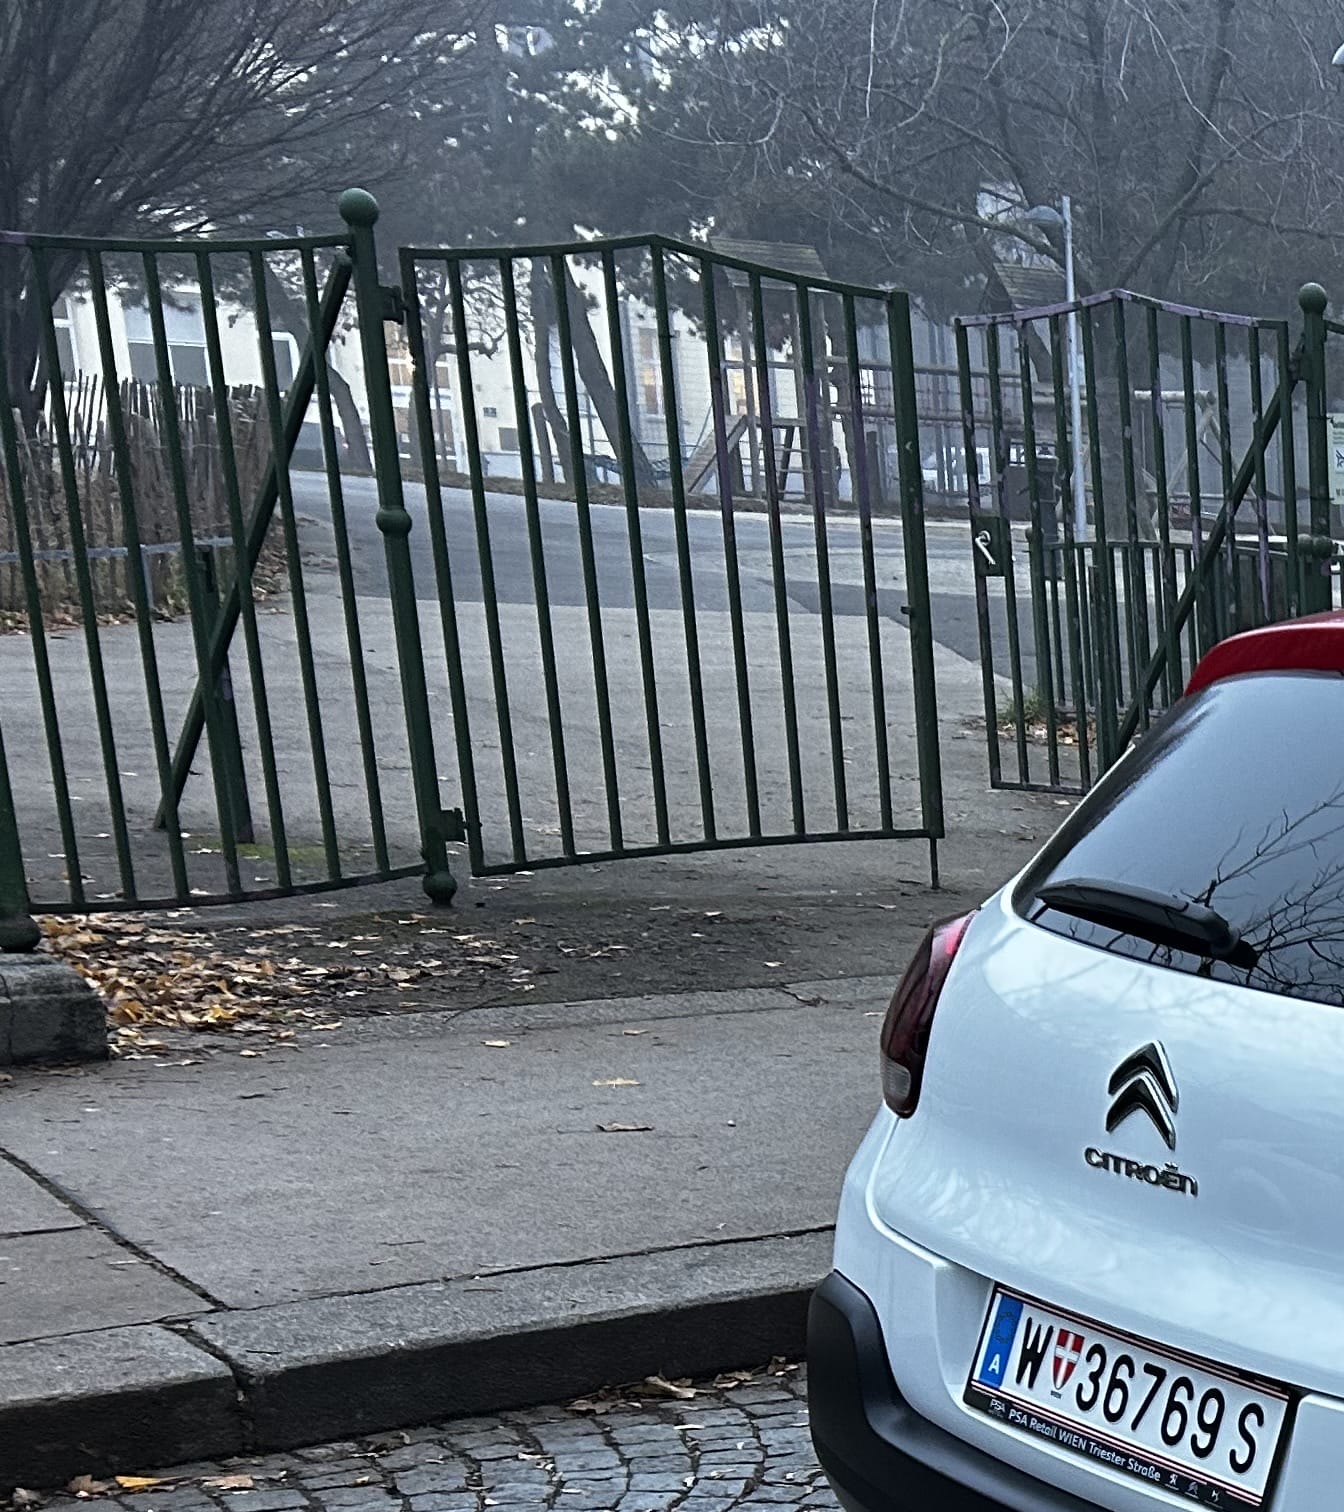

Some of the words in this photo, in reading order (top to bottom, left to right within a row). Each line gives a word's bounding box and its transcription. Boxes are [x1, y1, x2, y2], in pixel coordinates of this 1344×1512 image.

[1084, 1146, 1198, 1197] CITROËN
[988, 1353, 1001, 1375] A
[1015, 1316, 1054, 1389] W
[1075, 1343, 1225, 1458] 36769
[1229, 1403, 1265, 1474] S
[1008, 1409, 1028, 1427] PSA
[1029, 1418, 1058, 1439] Retail
[1058, 1428, 1087, 1451] WIEN
[1089, 1441, 1126, 1466] Triester
[1127, 1457, 1161, 1482] Straße
